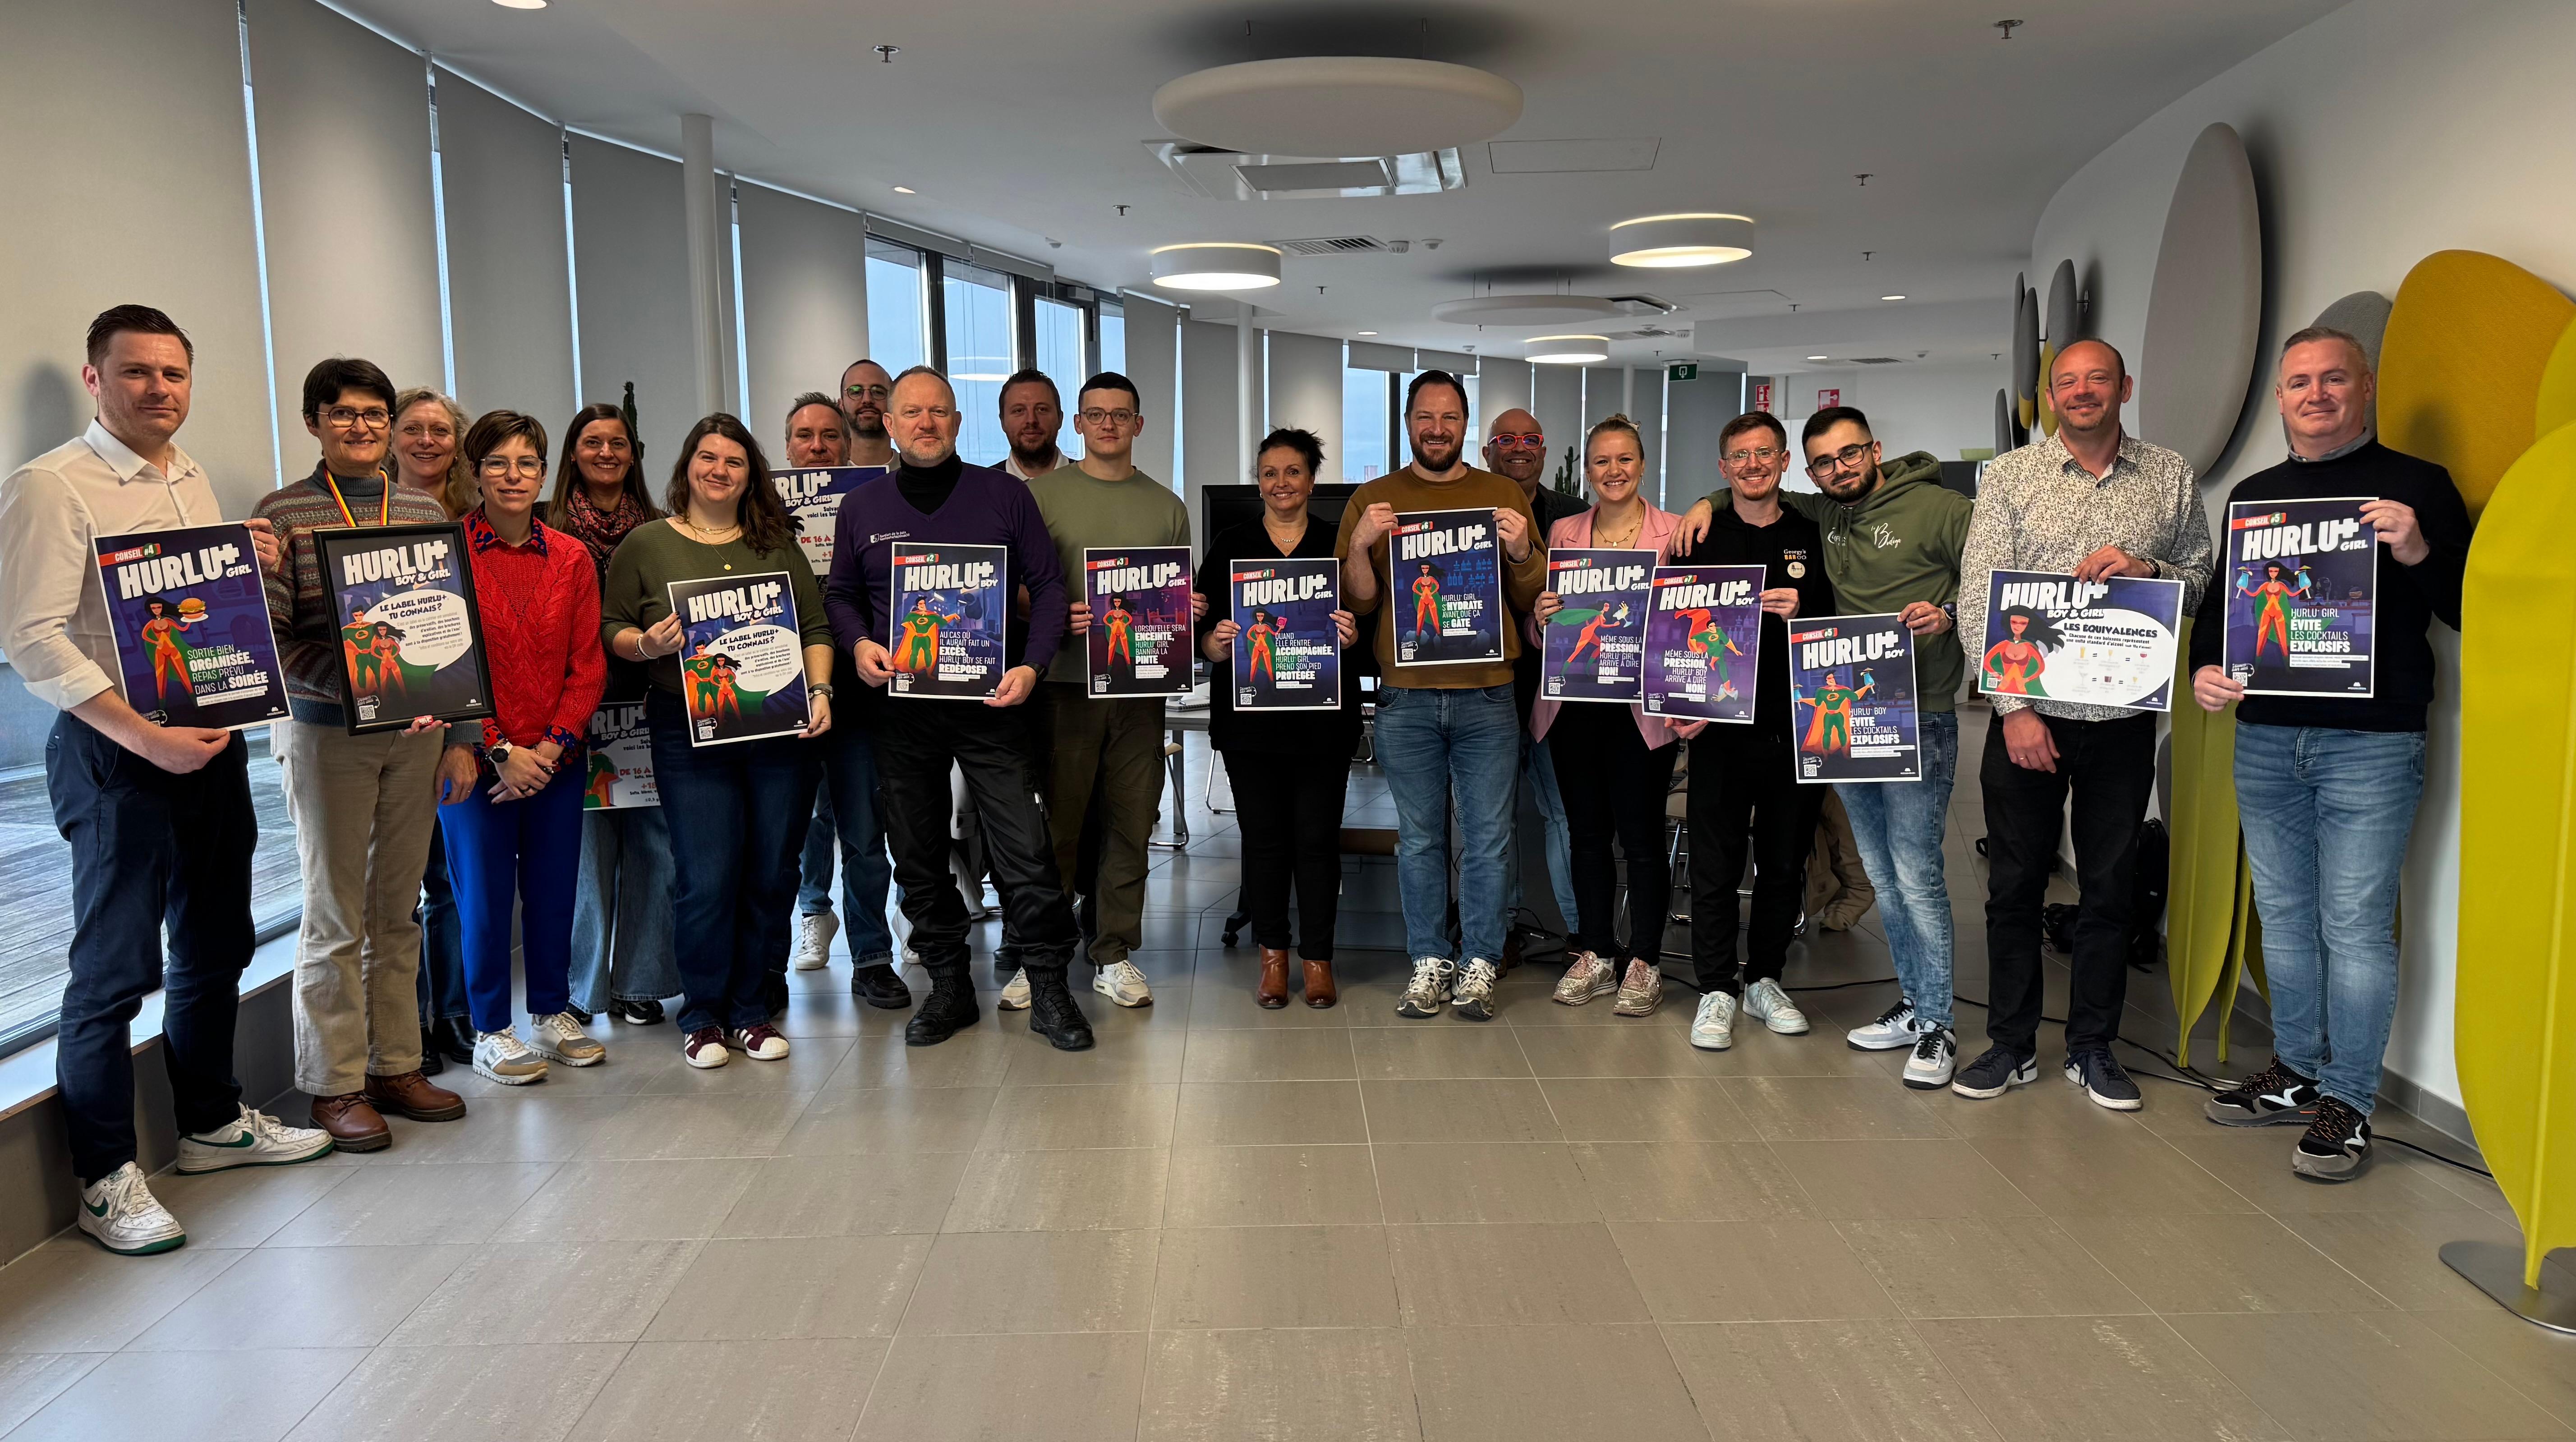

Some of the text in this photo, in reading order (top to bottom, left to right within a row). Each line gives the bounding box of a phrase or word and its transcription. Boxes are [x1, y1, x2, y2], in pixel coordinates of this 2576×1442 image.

[786, 499, 803, 507] BOY
[813, 495, 832, 503] GIRL
[2245, 516, 2269, 527] CONSEIL
[1402, 524, 1421, 533] CONSEIL
[1402, 524, 1486, 560] HURLU+
[2242, 518, 2359, 561] HURLU+
[1474, 541, 1493, 550] GIRL
[2340, 540, 2368, 551] GIRL
[115, 544, 154, 561] CONSEIL #4
[343, 540, 448, 585] HURLU+
[905, 555, 925, 563] CONSEIL
[1097, 559, 1116, 568] CONSEIL
[118, 543, 239, 600] HURLU+
[226, 564, 252, 577] GIRL
[904, 561, 994, 591] HURLU+
[1243, 571, 1262, 579] CONSEIL
[395, 569, 451, 586] BOY & GIRL
[1097, 562, 1180, 595] HURLU+
[1168, 579, 1187, 587] GIRL
[1557, 565, 1645, 595] HURLU+
[980, 579, 998, 588] BOY
[1631, 582, 1650, 591] GIRL
[1243, 574, 1327, 606] HURLU+
[1315, 591, 1333, 599] GIRL
[1659, 580, 1751, 611] HURLU+
[1736, 597, 1755, 606] BOY
[2001, 581, 2108, 611] HURLU+
[391, 600, 415, 611] LABEL
[688, 581, 781, 623] HURLU+
[1442, 600, 1483, 611] S'HYDRATE
[734, 606, 783, 622] BOY & GIRL
[1472, 610, 1480, 618] ÇA
[2047, 610, 2068, 618] BOY
[2080, 609, 2104, 617] GIRL
[2322, 608, 2339, 617] GIRL
[1451, 617, 1471, 628] GÂTE
[2291, 616, 2322, 631] ÉVITE
[962, 630, 971, 639] OÙ
[1803, 631, 1824, 640] CONSEIL
[2064, 623, 2157, 638] LES ÉQUIVALENCES
[2291, 631, 2348, 640] LES COCKTAILS
[729, 634, 751, 644] LABEL
[1135, 632, 1174, 641] ENCEINTE,
[1601, 634, 1617, 643] MÊME
[187, 644, 235, 659] SORTIE BIEN
[939, 644, 968, 657] EXCÈS,
[1275, 644, 1334, 656] ACCOMPAGNÉE,
[1600, 643, 1642, 654] PRESSION,
[1803, 630, 1898, 670] HURLU+
[2290, 641, 2350, 652] EXPLOSIFS
[1665, 649, 1682, 657] MÊME
[1885, 649, 1904, 659] BOY
[189, 650, 254, 672] ORGANISÉE,
[1136, 655, 1158, 664] PINTE
[1664, 658, 1707, 670] PRESSION,
[193, 666, 244, 682] REPAS PRÉVU
[938, 663, 987, 675] REDÉPOSER
[1276, 669, 1316, 680] PROTÉGÉE
[1599, 666, 1618, 676] NON!
[195, 670, 269, 695] DANS LA SOIRÉE
[1688, 675, 1691, 683] À
[1685, 684, 1706, 693] NON!
[602, 732, 619, 740] BOY
[630, 727, 649, 736] GIRL
[1863, 726, 1897, 734] COCKTAILS
[1851, 735, 1900, 745] EXPLOSIFS
